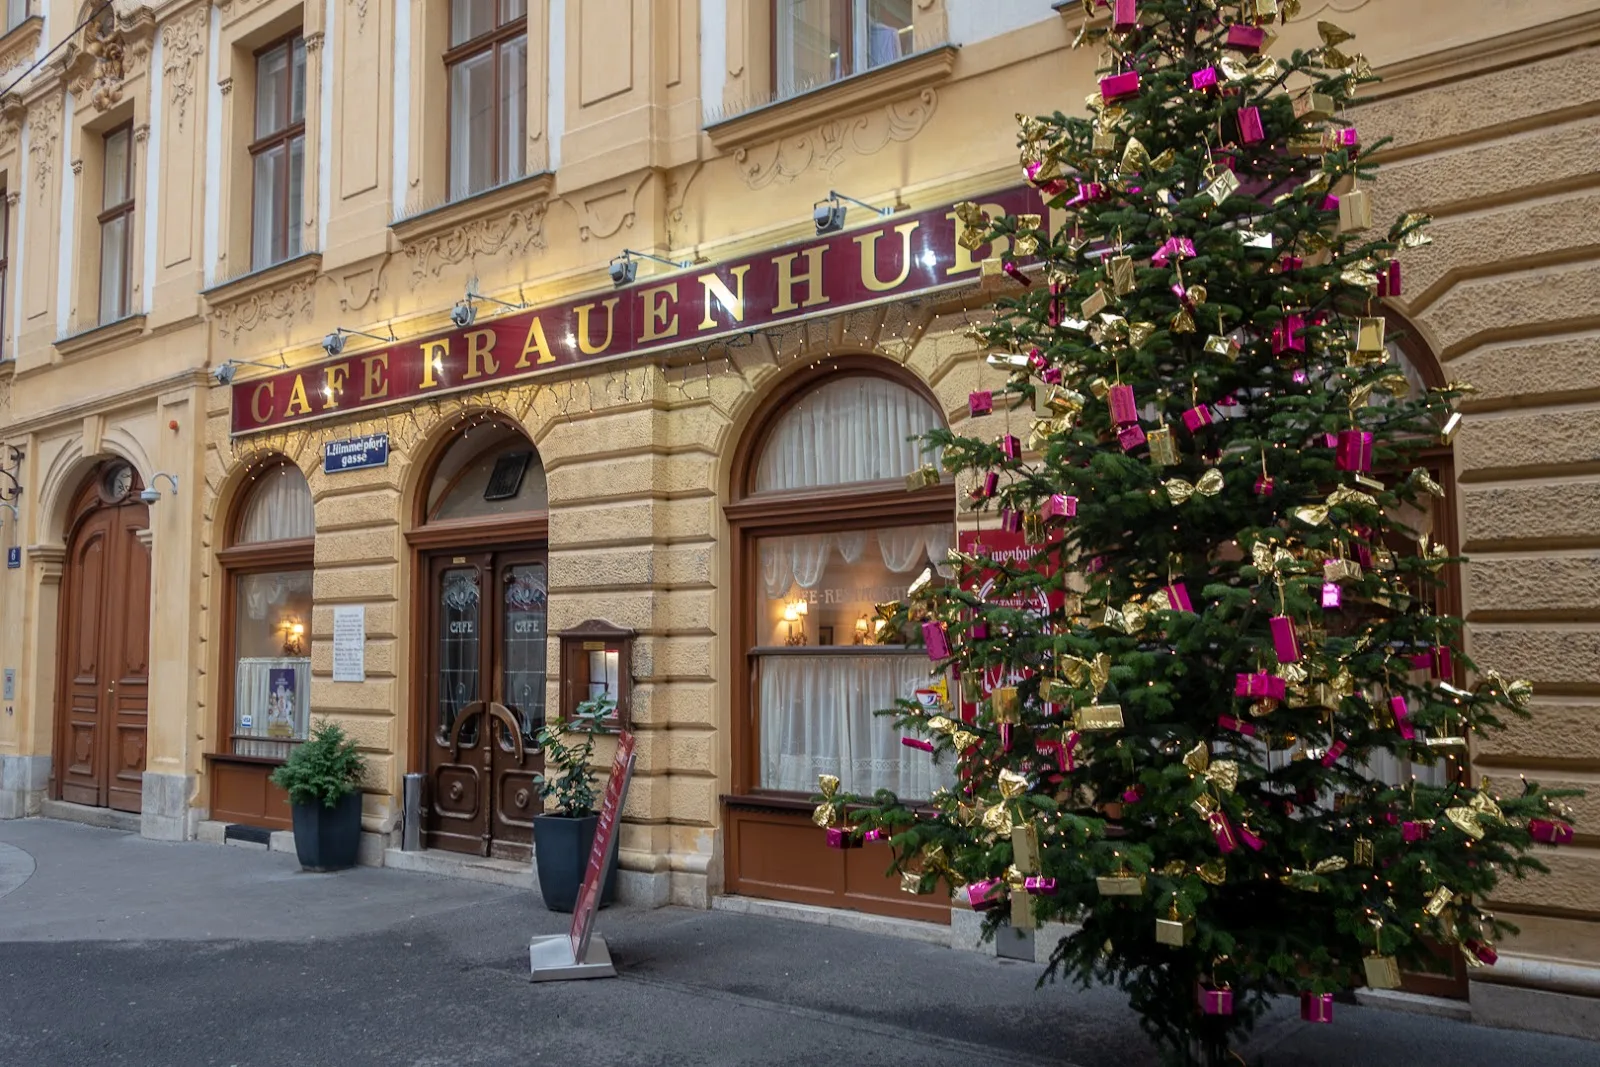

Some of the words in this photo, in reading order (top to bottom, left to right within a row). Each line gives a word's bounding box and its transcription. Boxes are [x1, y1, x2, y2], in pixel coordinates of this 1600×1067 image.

[251, 353, 390, 424] CAFE
[341, 453, 368, 468] gasse
[11, 549, 16, 561] 6
[450, 621, 473, 633] CAFE
[514, 620, 540, 632] CAFE
